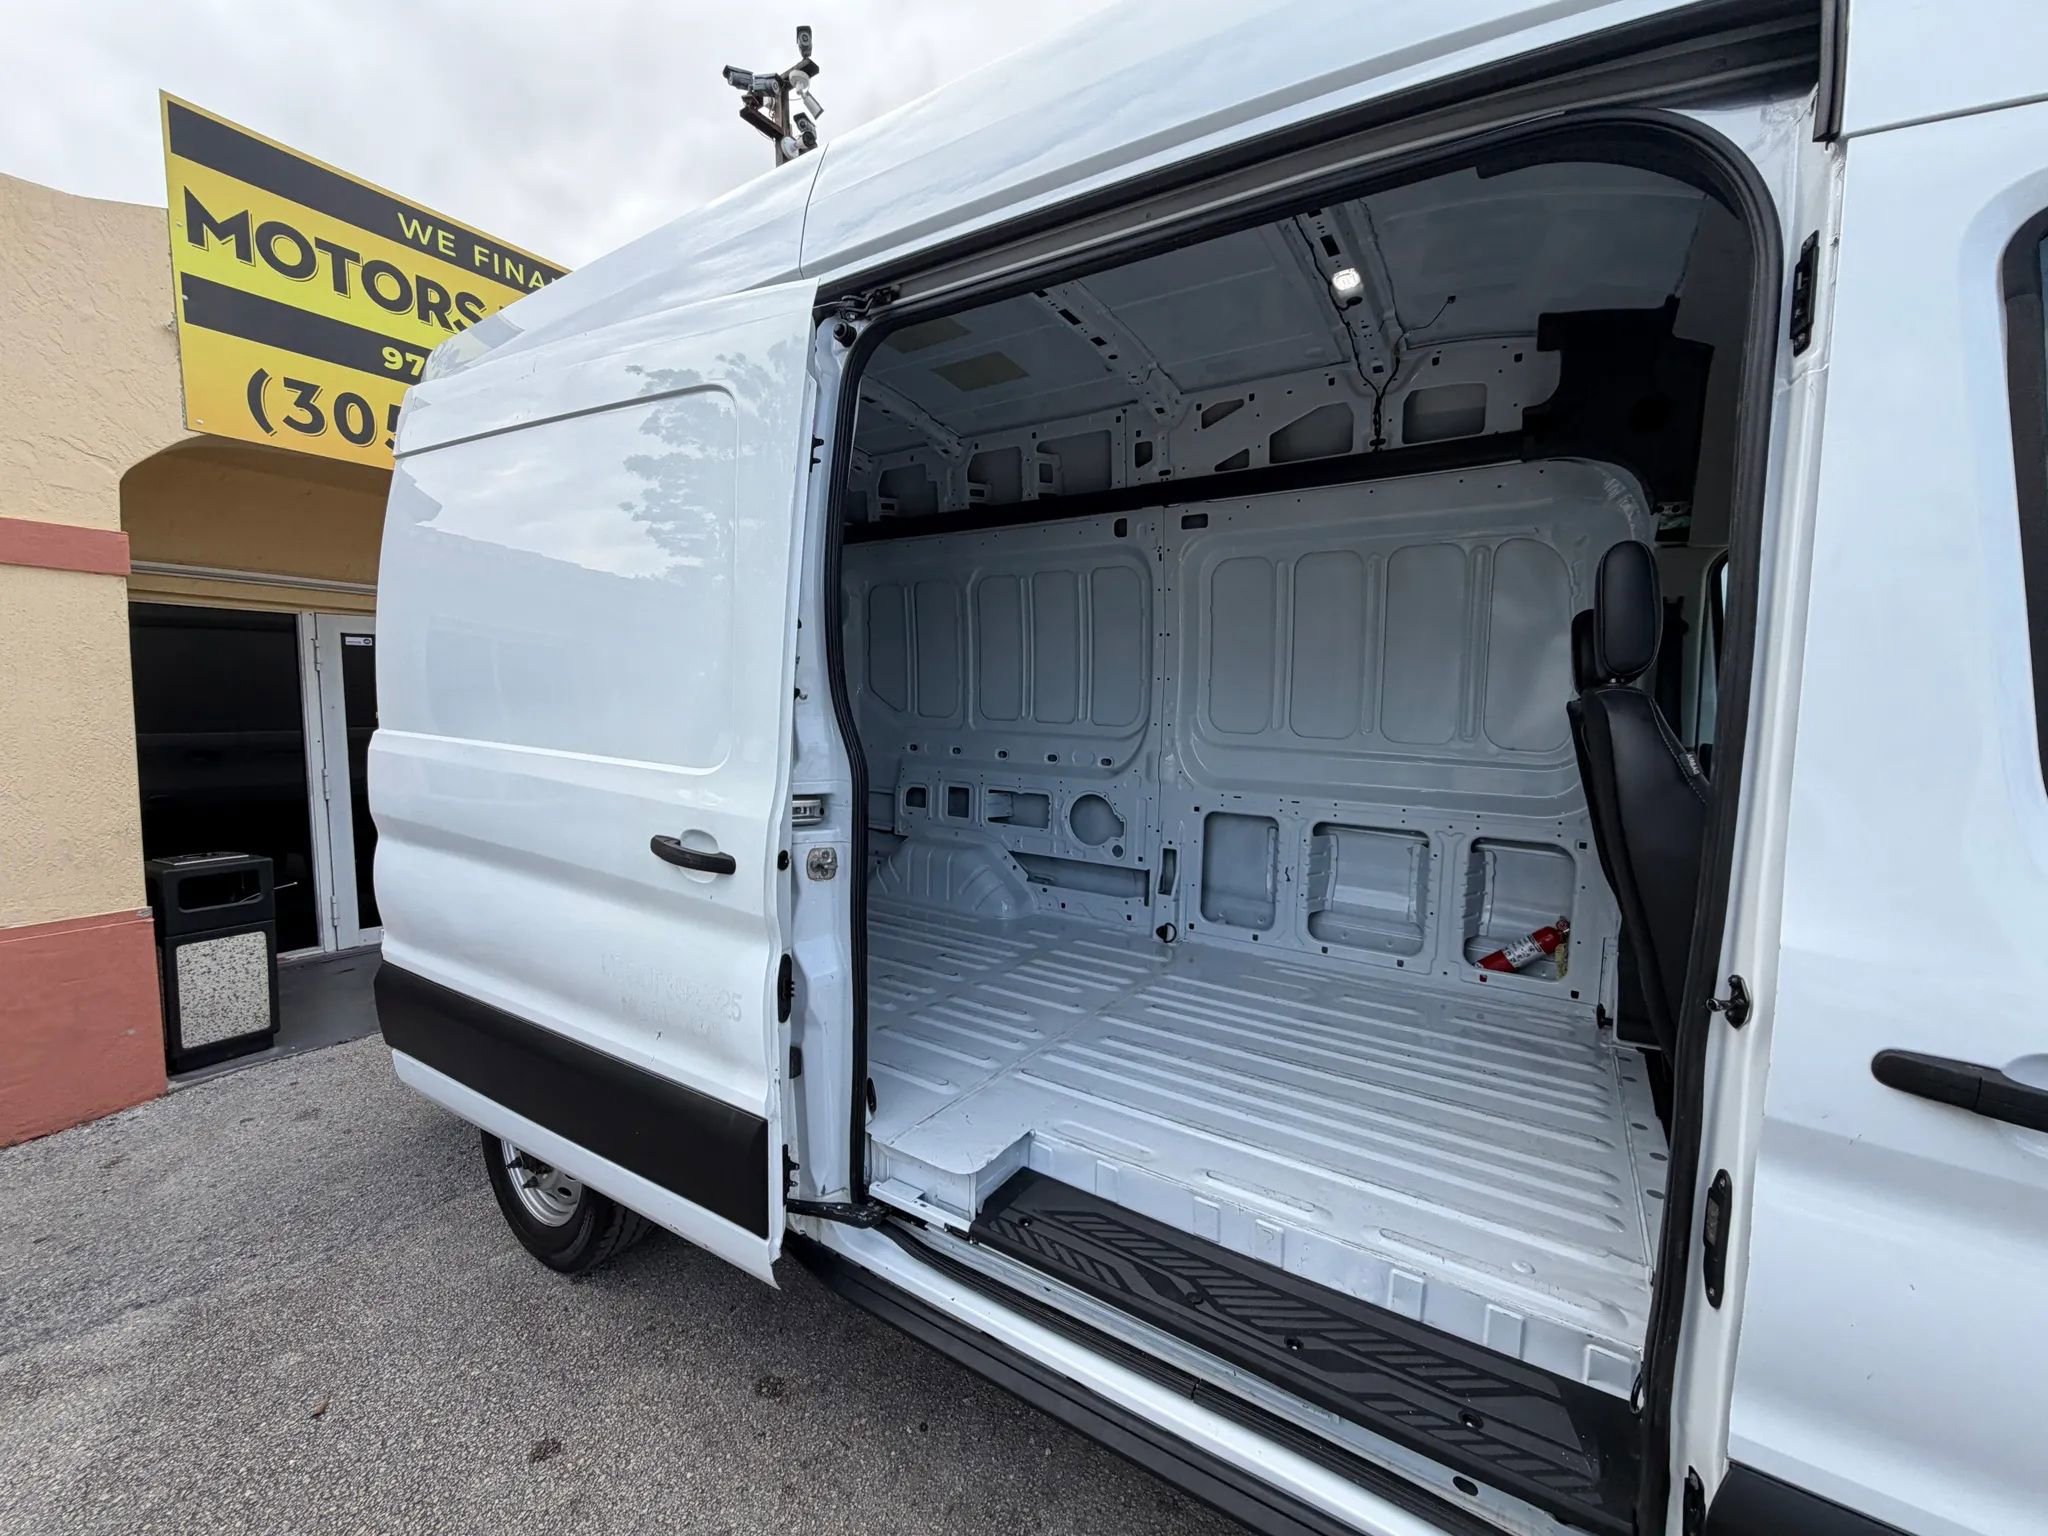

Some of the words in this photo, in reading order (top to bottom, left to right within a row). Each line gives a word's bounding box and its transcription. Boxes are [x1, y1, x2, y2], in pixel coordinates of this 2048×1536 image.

[183, 184, 488, 334] MOTORS
[397, 212, 457, 258] WE
[473, 244, 557, 289] FINA
